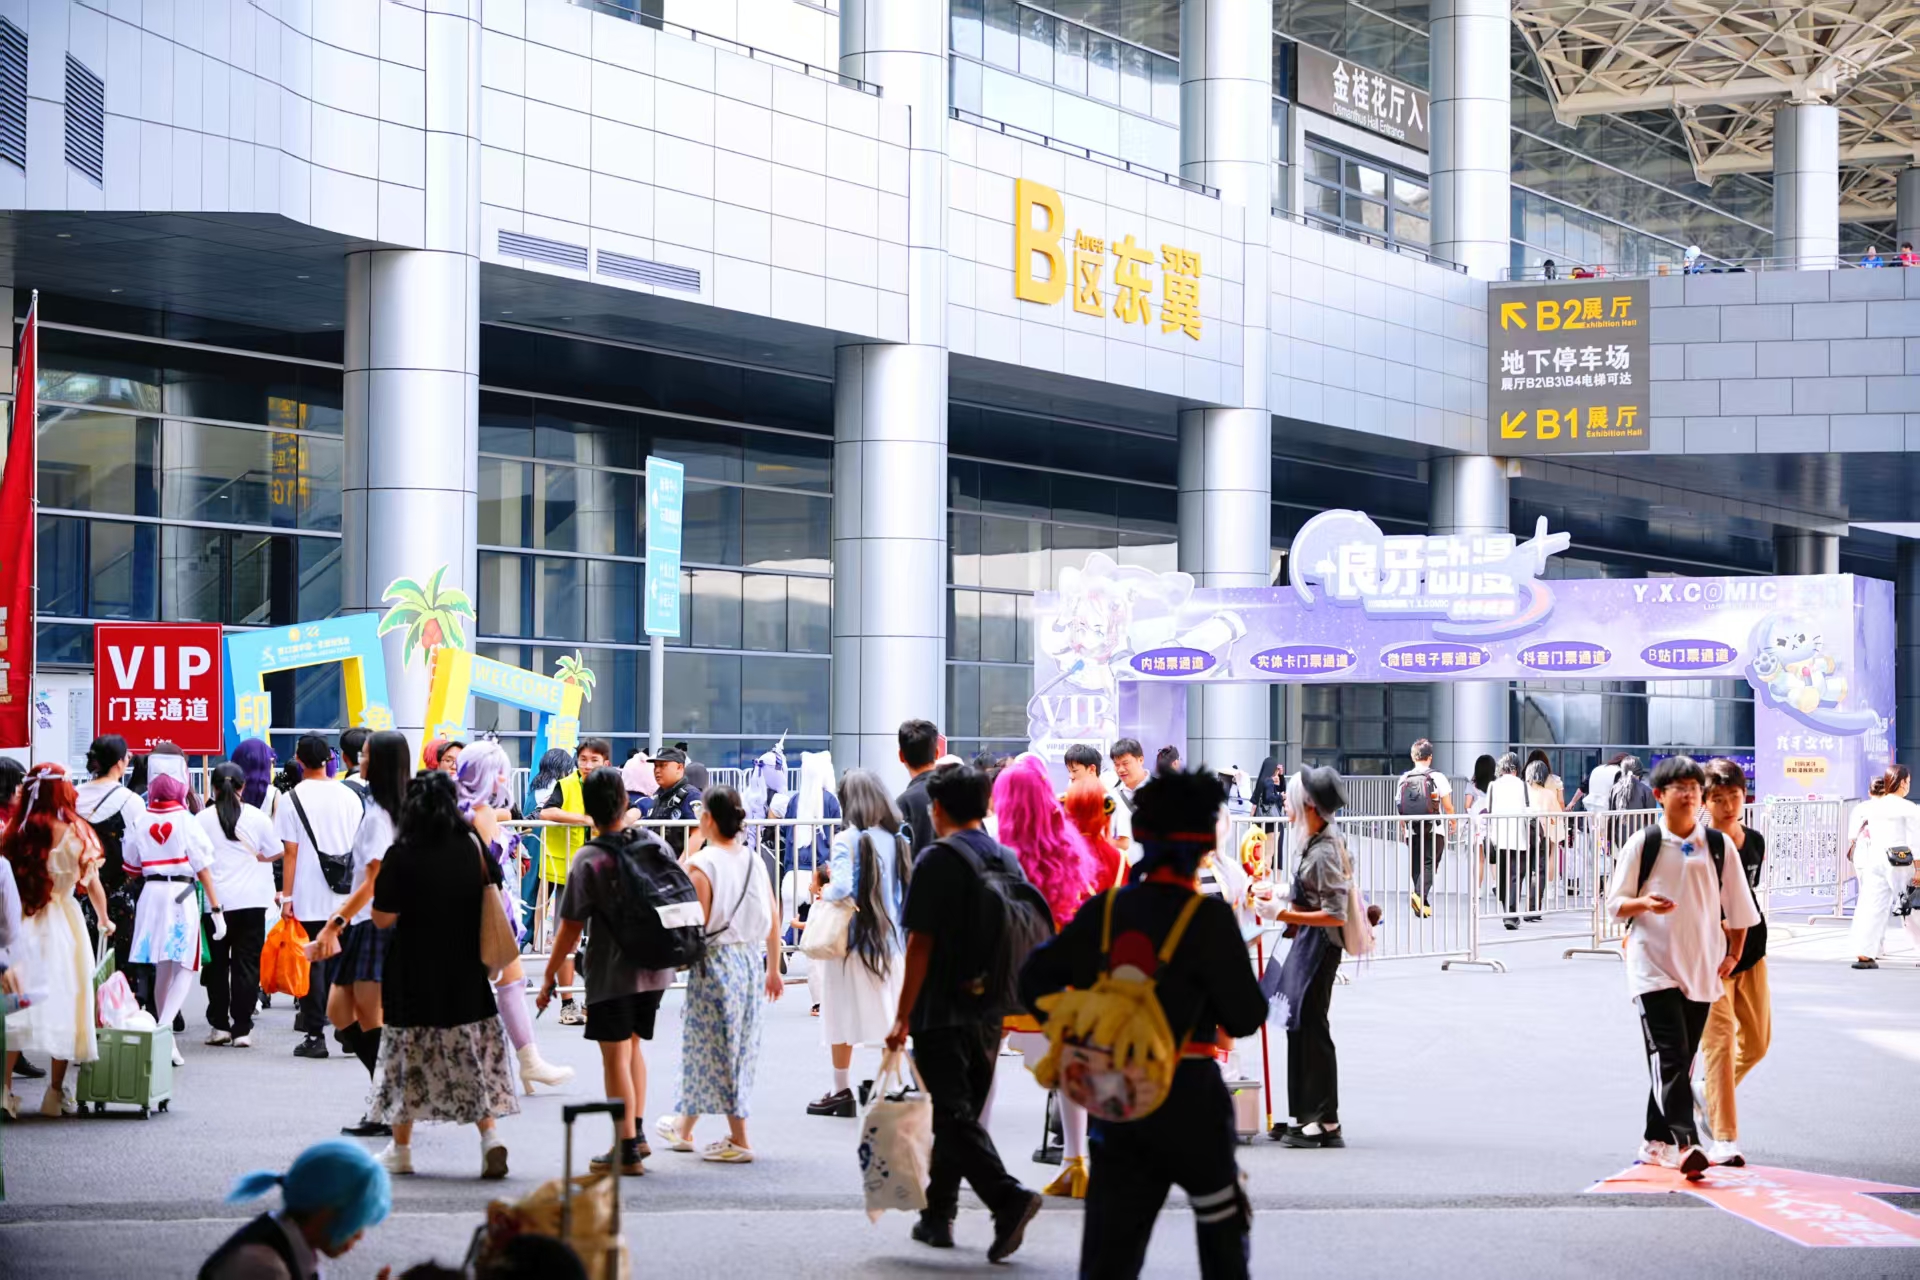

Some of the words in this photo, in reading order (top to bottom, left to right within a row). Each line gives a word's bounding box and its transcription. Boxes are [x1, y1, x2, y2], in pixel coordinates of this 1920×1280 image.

[1332, 60, 1430, 133] 金桂花厅入
[1333, 102, 1366, 125] Osmanthus
[1367, 115, 1379, 130] Hall
[1074, 228, 1105, 254] Area
[1621, 319, 1637, 327] Hall
[1501, 344, 1630, 375] 地下停车场
[1501, 372, 1632, 391] 展厅B2\B3\B4电梯可达
[1586, 429, 1626, 438] Exhibition
[1627, 428, 1643, 436] Hall
[107, 645, 212, 691] VIP
[1141, 656, 1204, 671] 内场票通道
[1257, 653, 1349, 669] 实体卡门票通道
[1388, 652, 1482, 667] 微信电子票通道
[1523, 651, 1608, 665] 抖音门票通道
[1649, 648, 1729, 663] B站门票通道
[475, 662, 559, 702] WELCOME
[108, 697, 209, 722] 门票通道
[239, 695, 269, 732] 印
[1038, 694, 1111, 728] VIP
